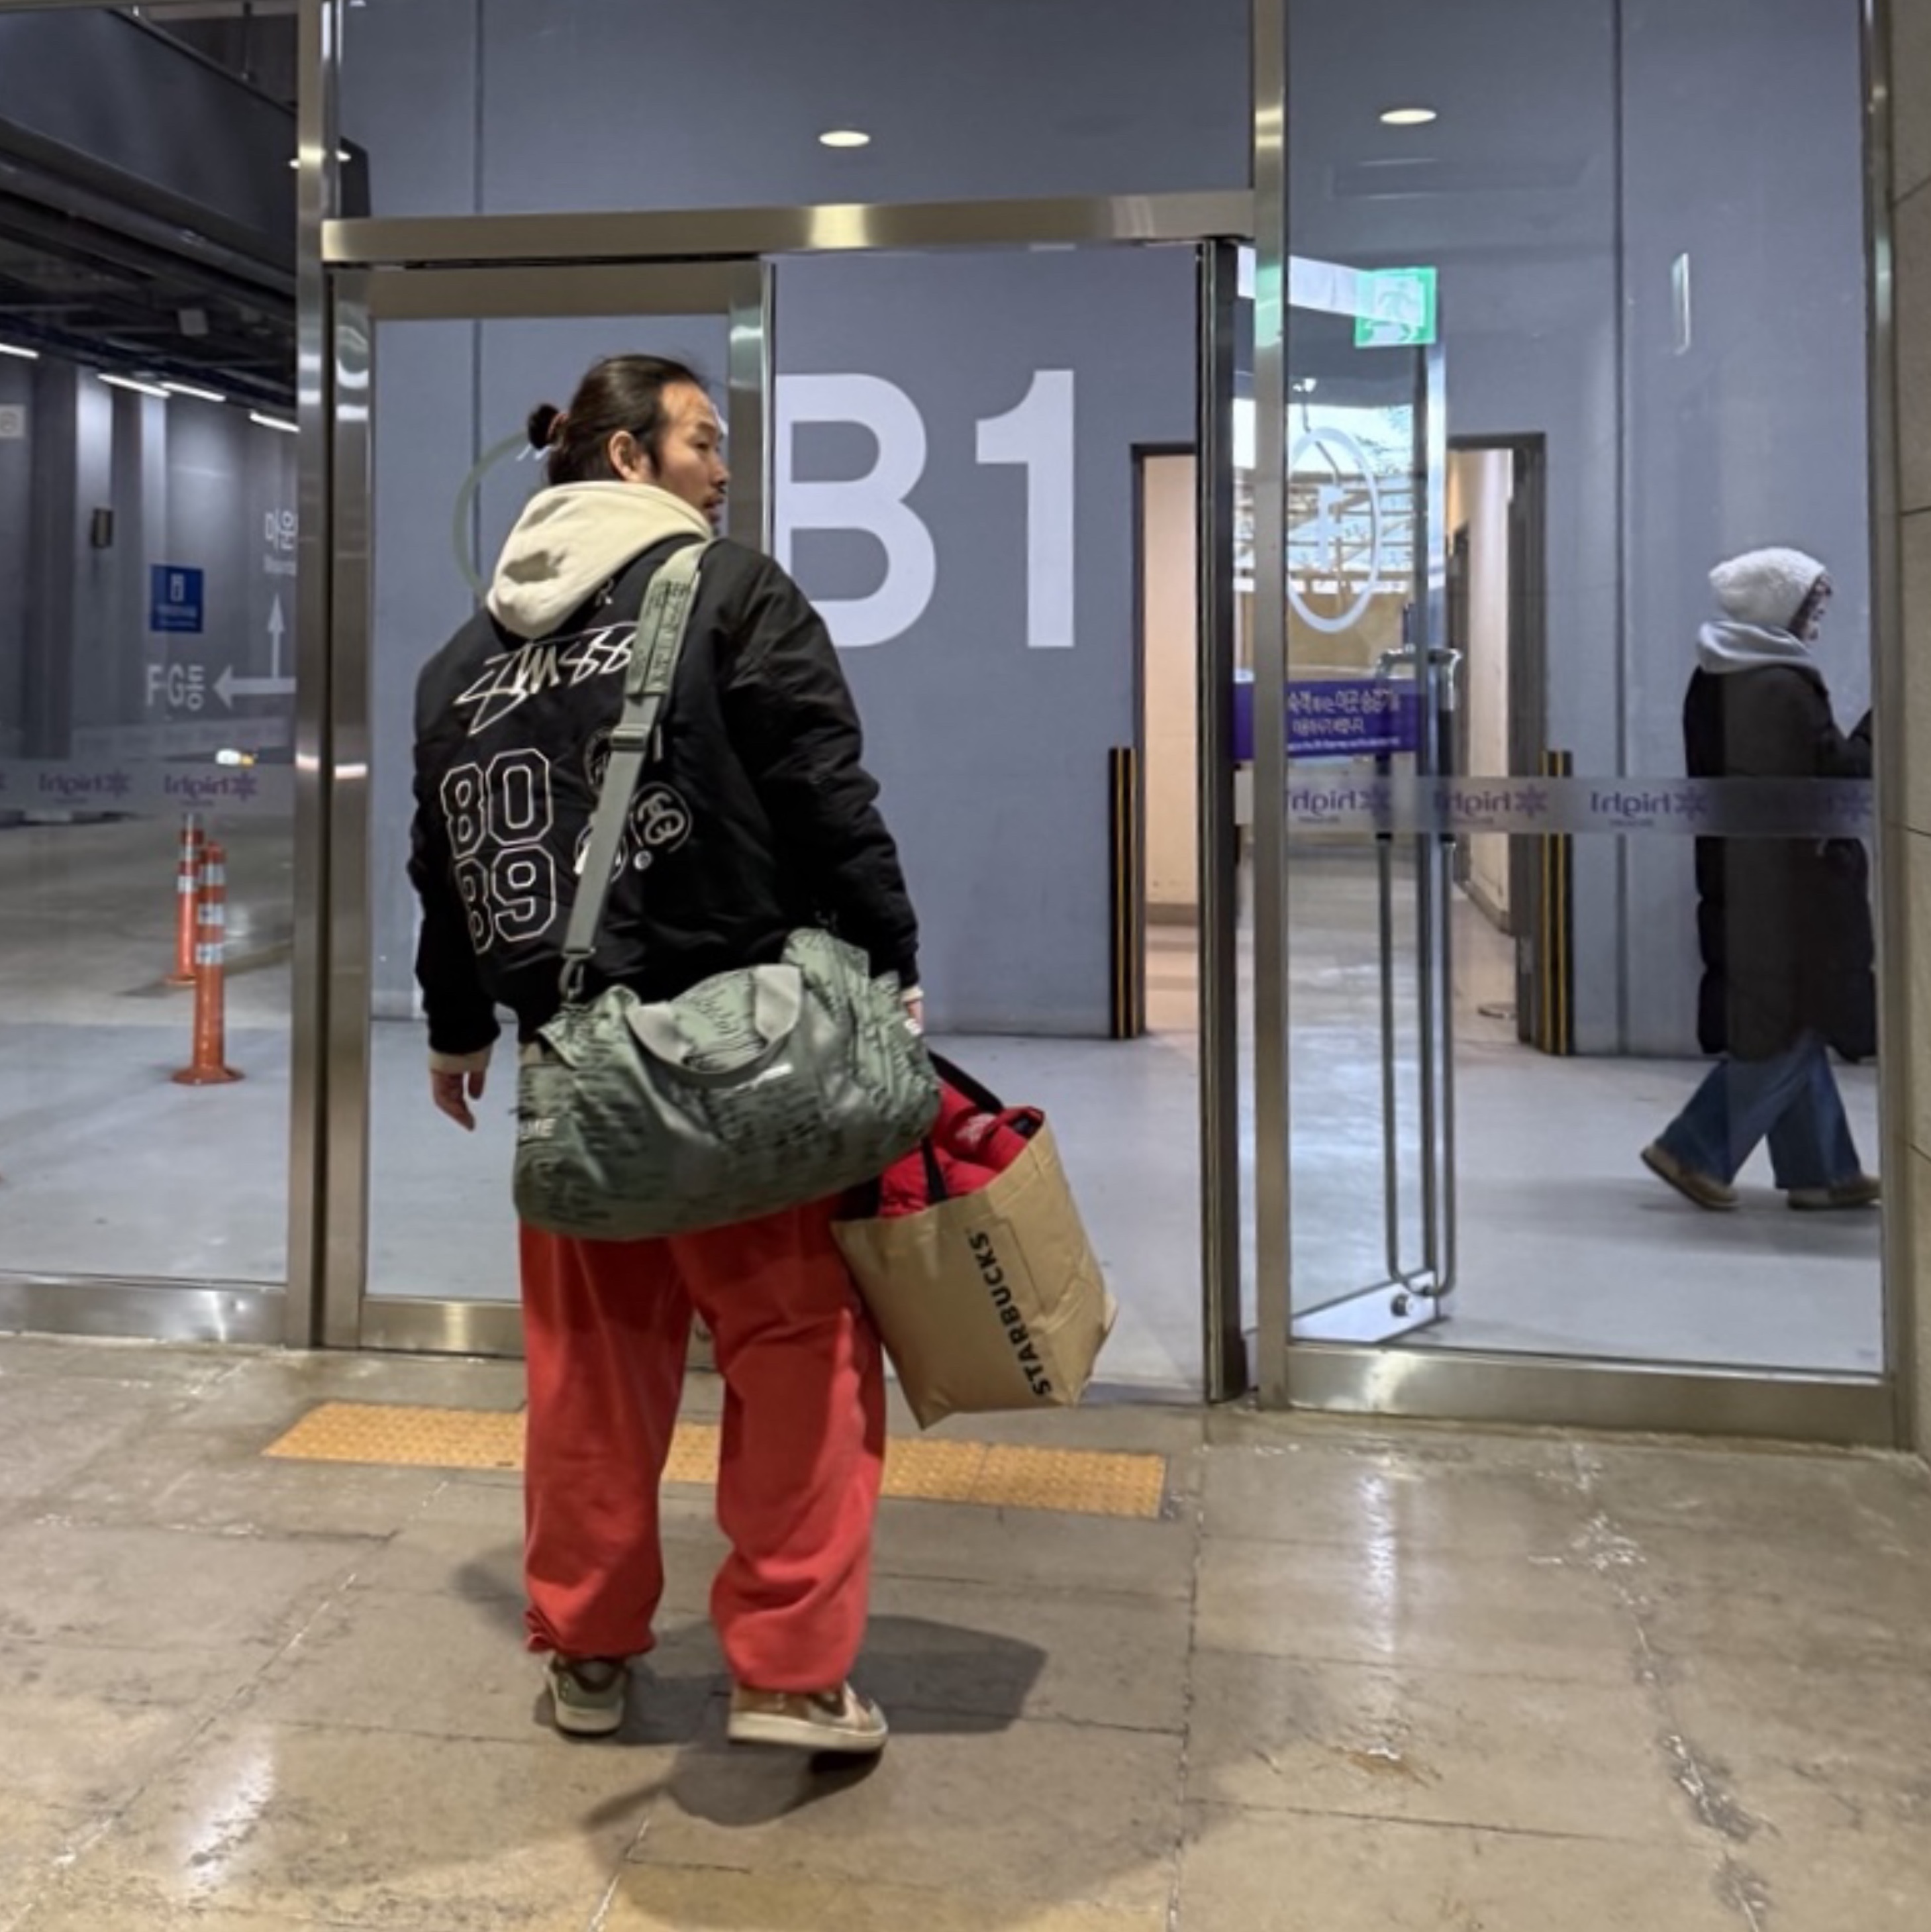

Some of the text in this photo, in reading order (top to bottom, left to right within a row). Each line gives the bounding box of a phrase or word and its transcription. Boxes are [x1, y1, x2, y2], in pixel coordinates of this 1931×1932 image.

[775, 368, 1074, 648] B1
[442, 748, 554, 859] 80
[969, 1231, 1052, 1396] STARBUCKS
